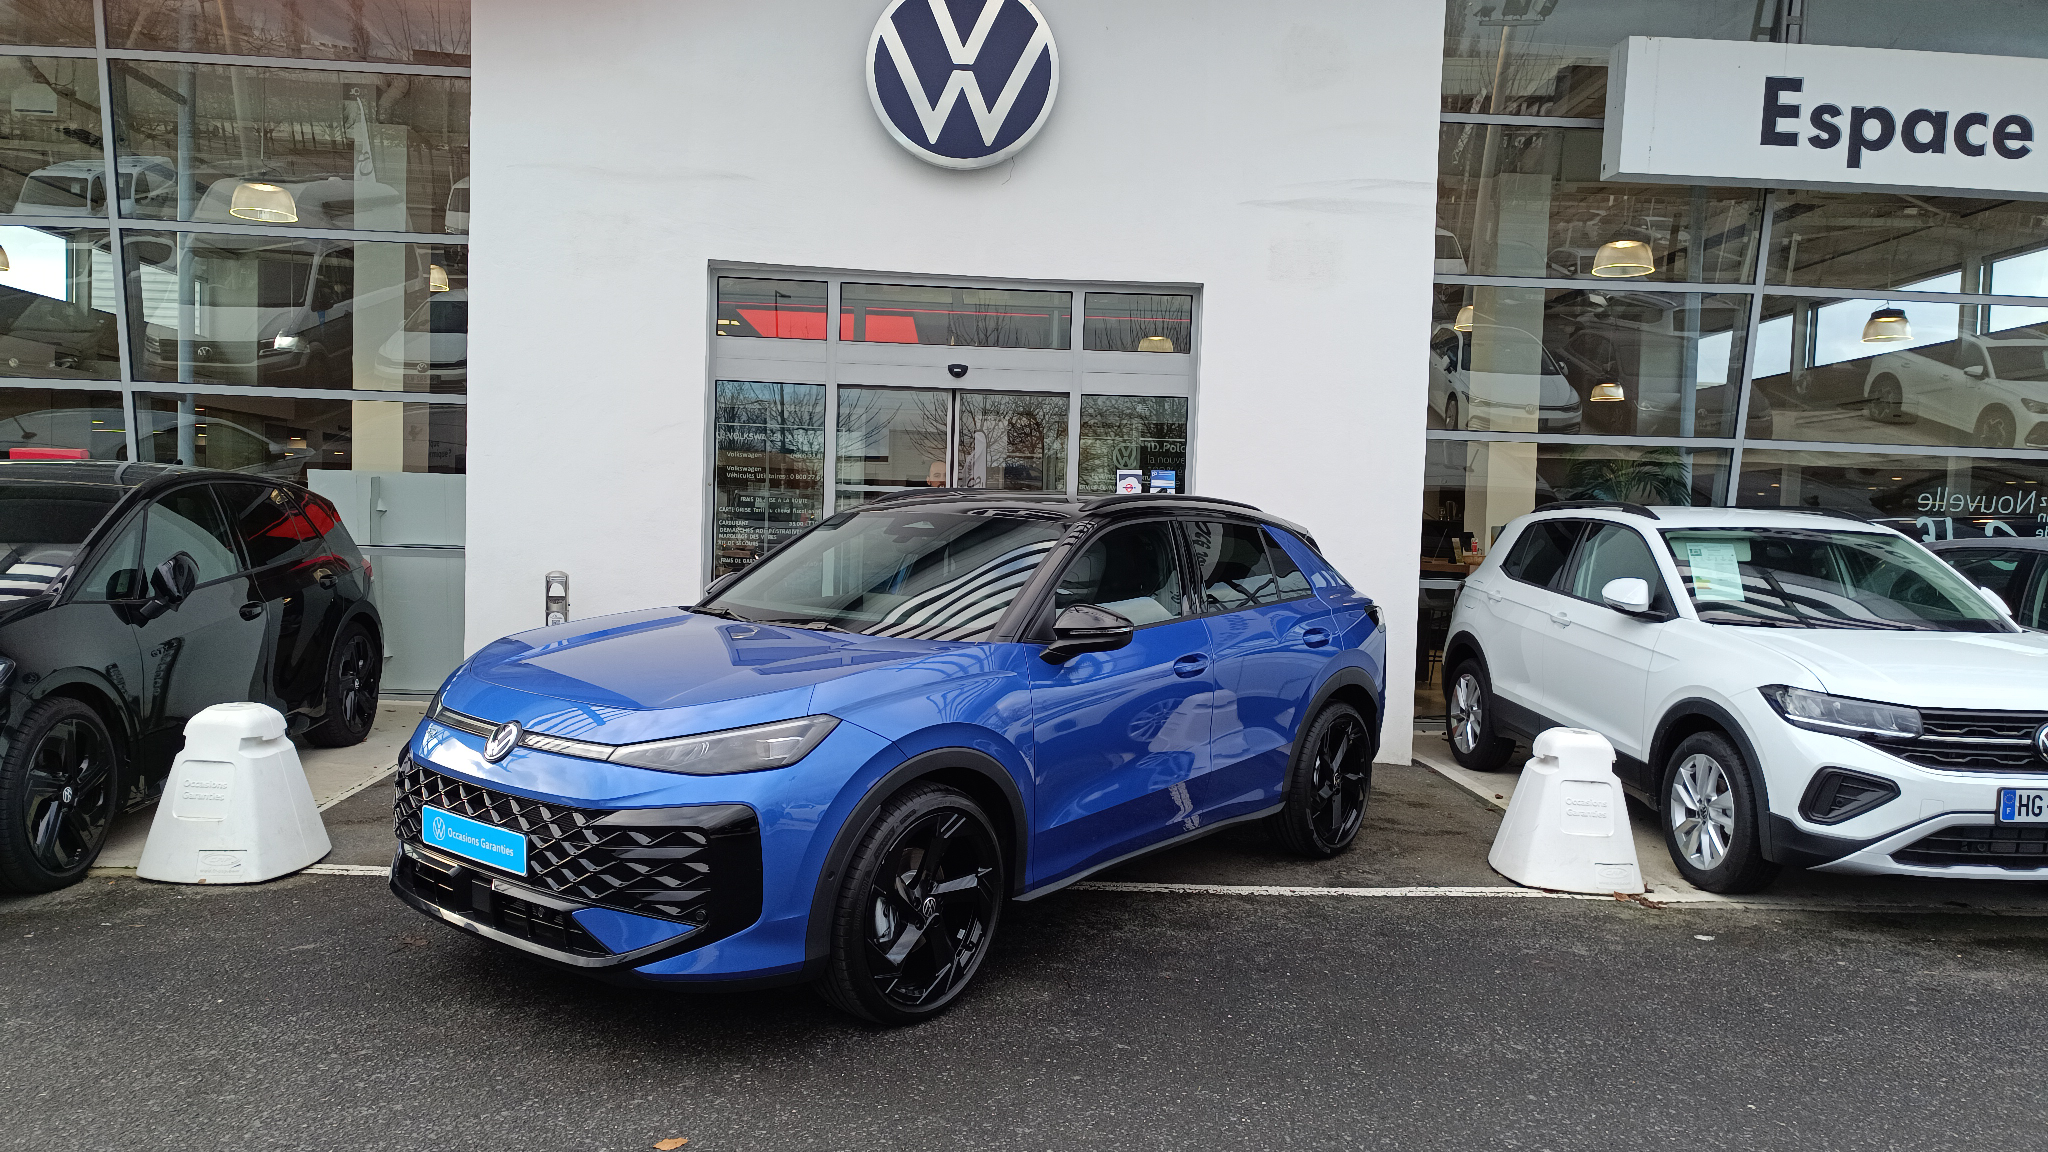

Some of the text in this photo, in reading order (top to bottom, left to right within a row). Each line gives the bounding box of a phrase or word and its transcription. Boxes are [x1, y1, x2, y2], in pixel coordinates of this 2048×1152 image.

[1759, 75, 2034, 169] Espace
[726, 451, 762, 459] Volkswagen
[1147, 455, 1155, 464] la
[726, 465, 762, 473] Volkswagen
[183, 779, 228, 790] Occasions
[182, 791, 226, 801] Garanties
[1565, 797, 1608, 808] Occasions
[1565, 808, 1608, 819] Garanties
[2006, 807, 2012, 815] F
[447, 827, 514, 857] Occasions Garanties
